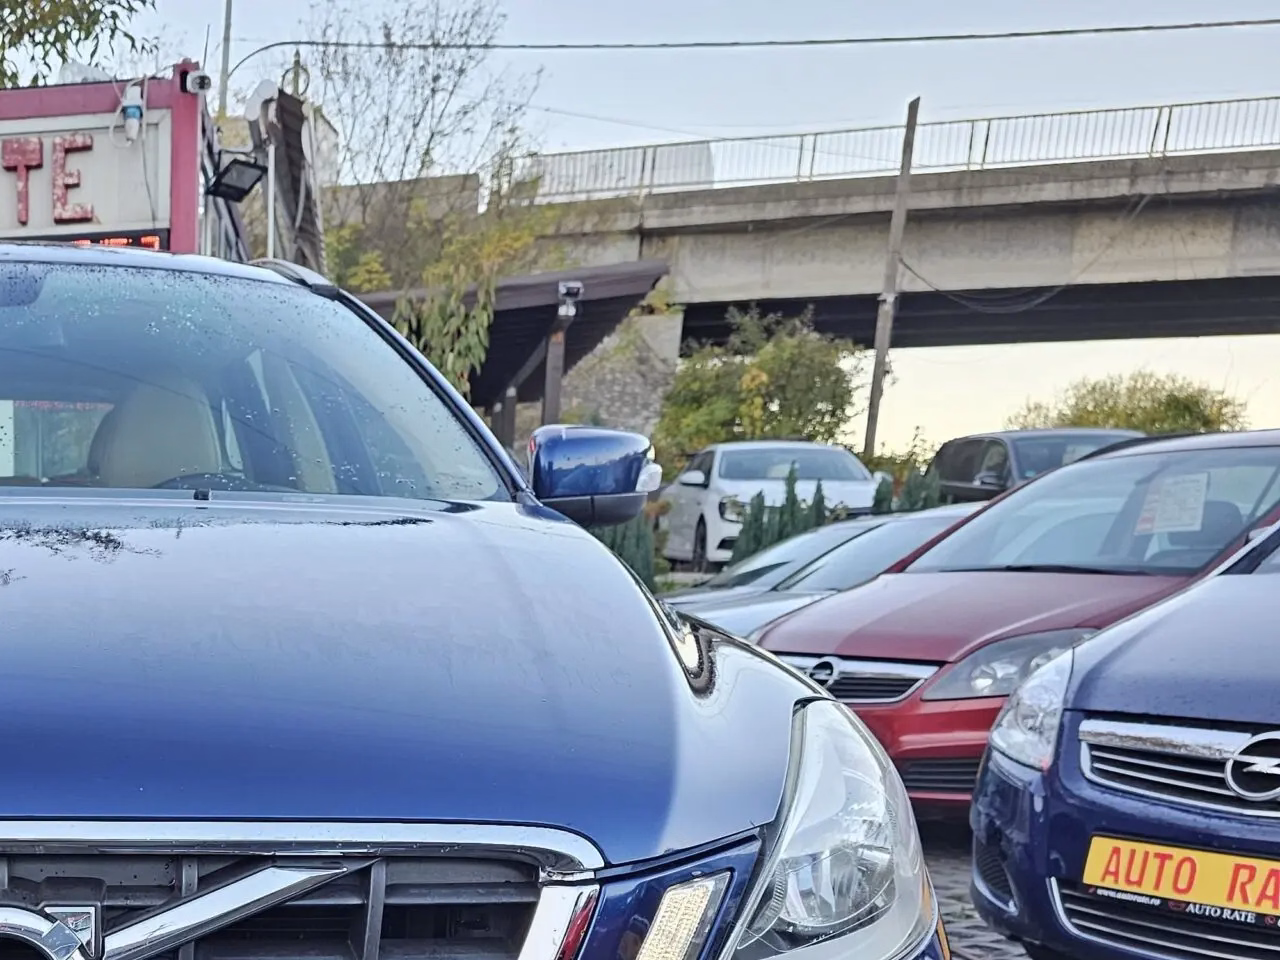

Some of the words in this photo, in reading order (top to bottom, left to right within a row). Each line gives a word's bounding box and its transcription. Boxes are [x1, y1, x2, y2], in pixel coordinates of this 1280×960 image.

[1100, 846, 1198, 895] AUTO
[1186, 903, 1220, 918] AUTO
[1222, 909, 1257, 924] RATE
